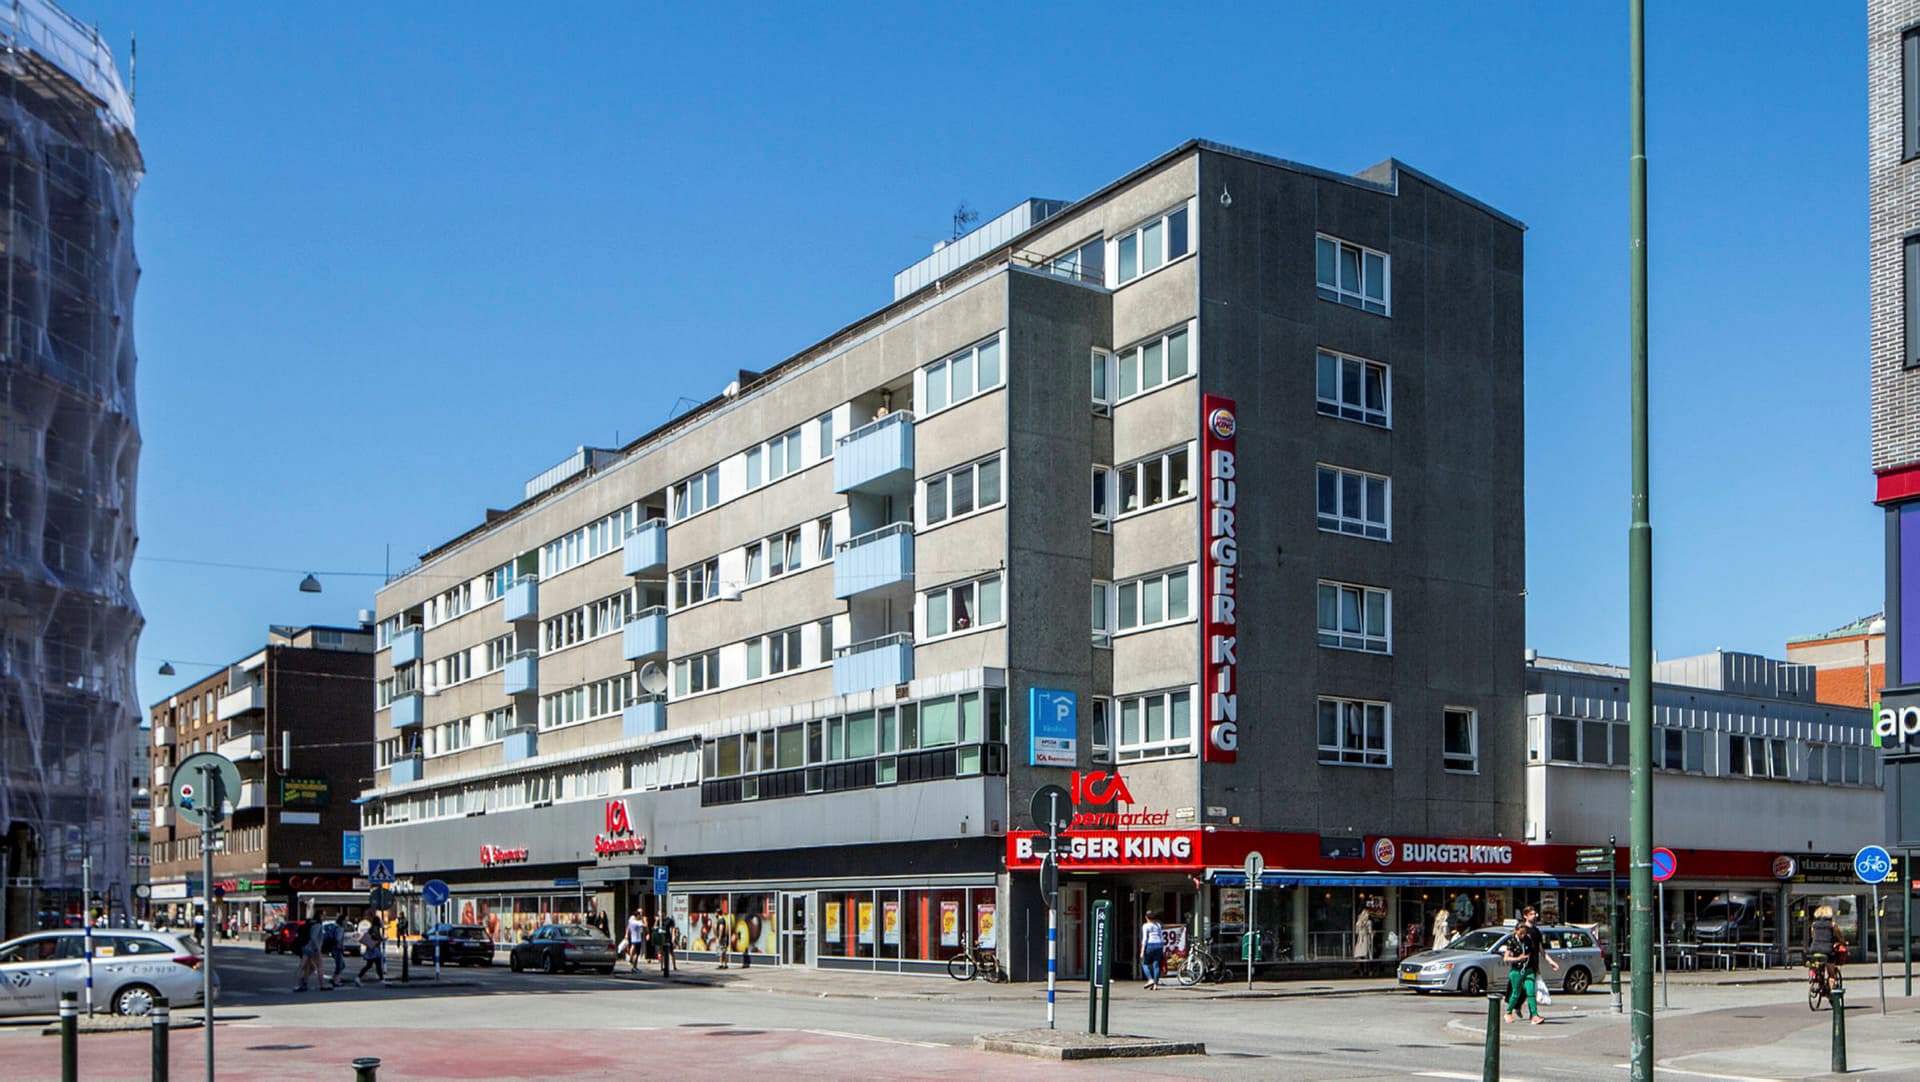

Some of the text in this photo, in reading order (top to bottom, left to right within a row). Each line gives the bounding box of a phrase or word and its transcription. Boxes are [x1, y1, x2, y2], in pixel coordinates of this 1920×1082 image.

[1215, 420, 1233, 431] KING
[1211, 449, 1237, 751] BURGER KING
[1057, 704, 1070, 721] P
[1071, 770, 1135, 805] ICA
[606, 799, 632, 833] ICA
[1016, 837, 1191, 859] BGER KING
[1402, 843, 1512, 864] BURGER KING
[658, 868, 666, 879] P
